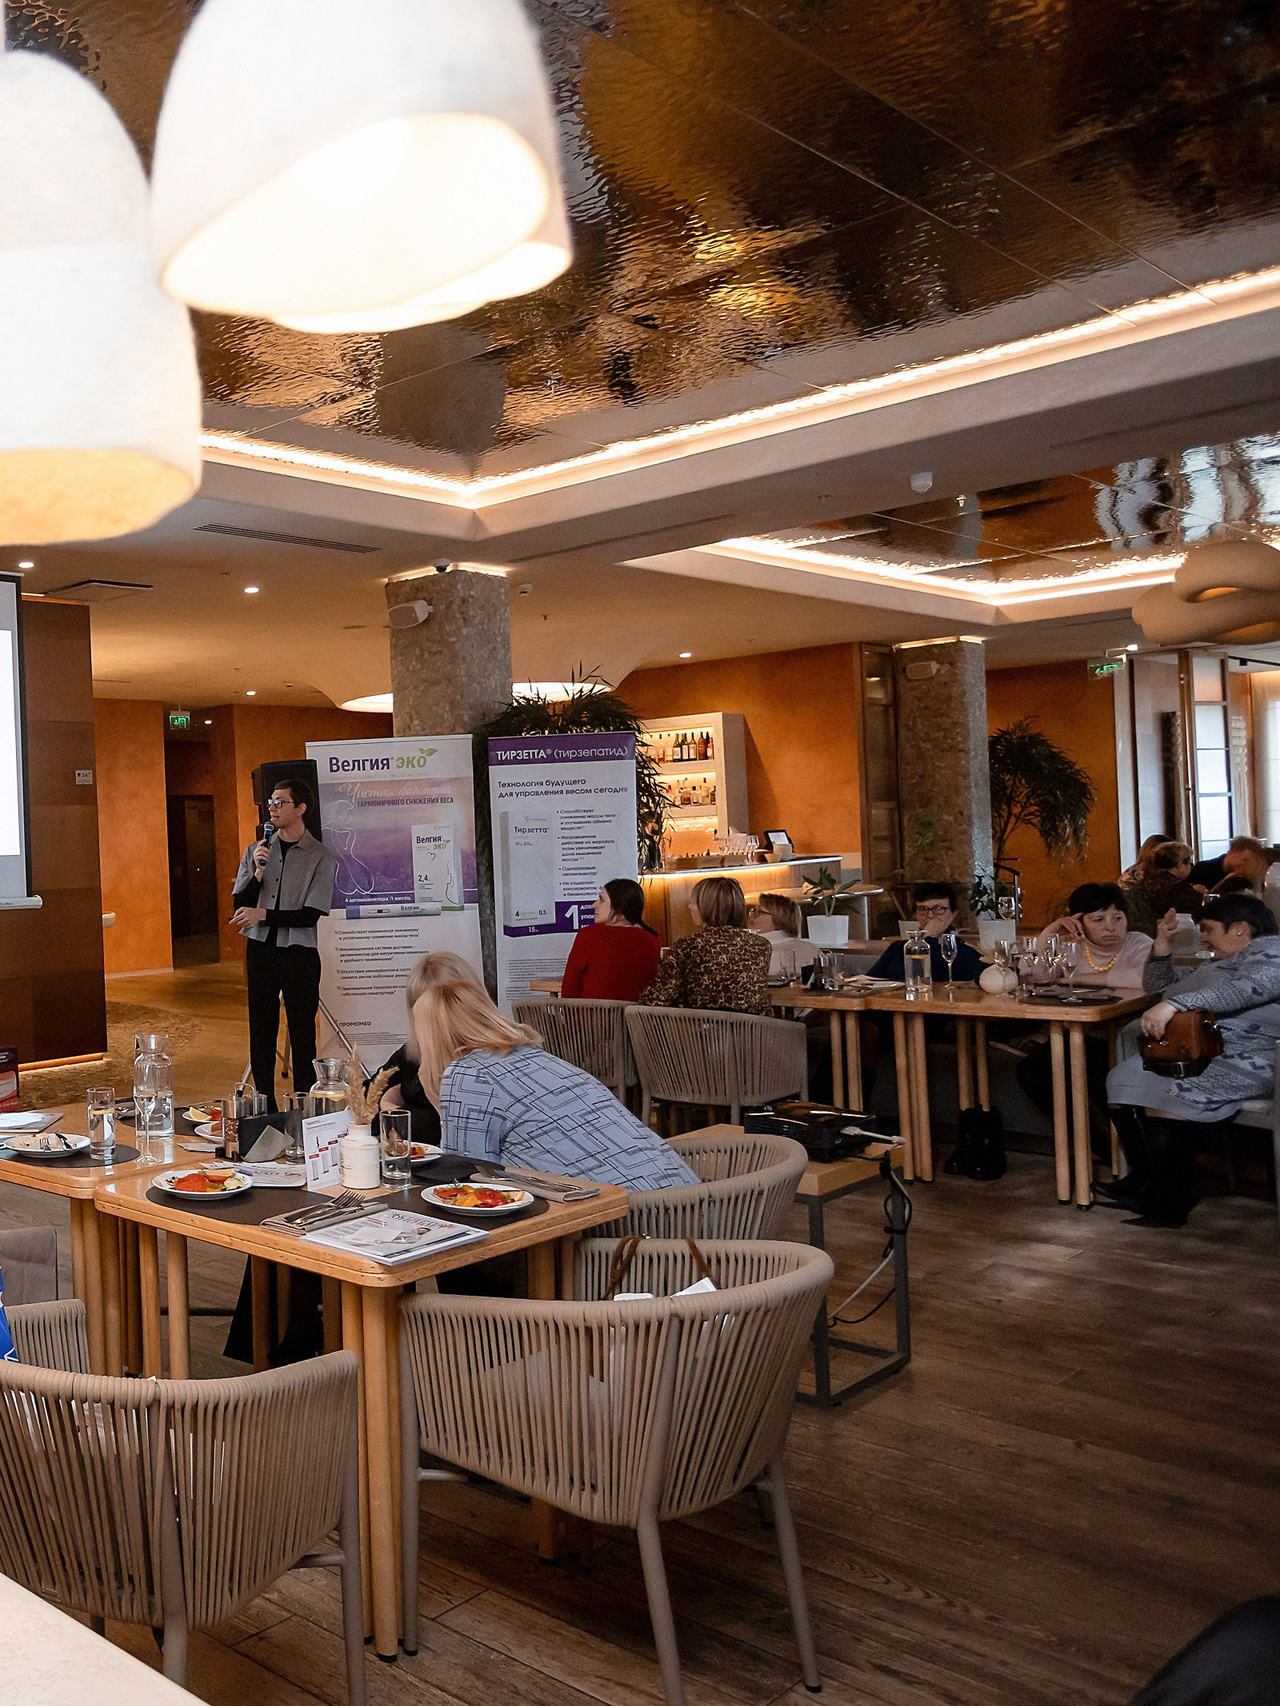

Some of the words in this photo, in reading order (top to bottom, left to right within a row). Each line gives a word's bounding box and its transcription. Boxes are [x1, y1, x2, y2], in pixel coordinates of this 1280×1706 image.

[553, 746, 628, 759] (тирзепатид)
[329, 757, 390, 773] Велгия
[497, 781, 544, 789] Технология
[545, 779, 586, 788] будущего
[498, 791, 514, 799] для
[515, 790, 564, 798] управления
[594, 786, 629, 794] сегодня
[357, 799, 405, 807] ГАРМОНИЧНОГО
[405, 798, 440, 806] СНИЖЕНИЯ
[416, 836, 442, 844] Велгия
[565, 904, 579, 930] 1
